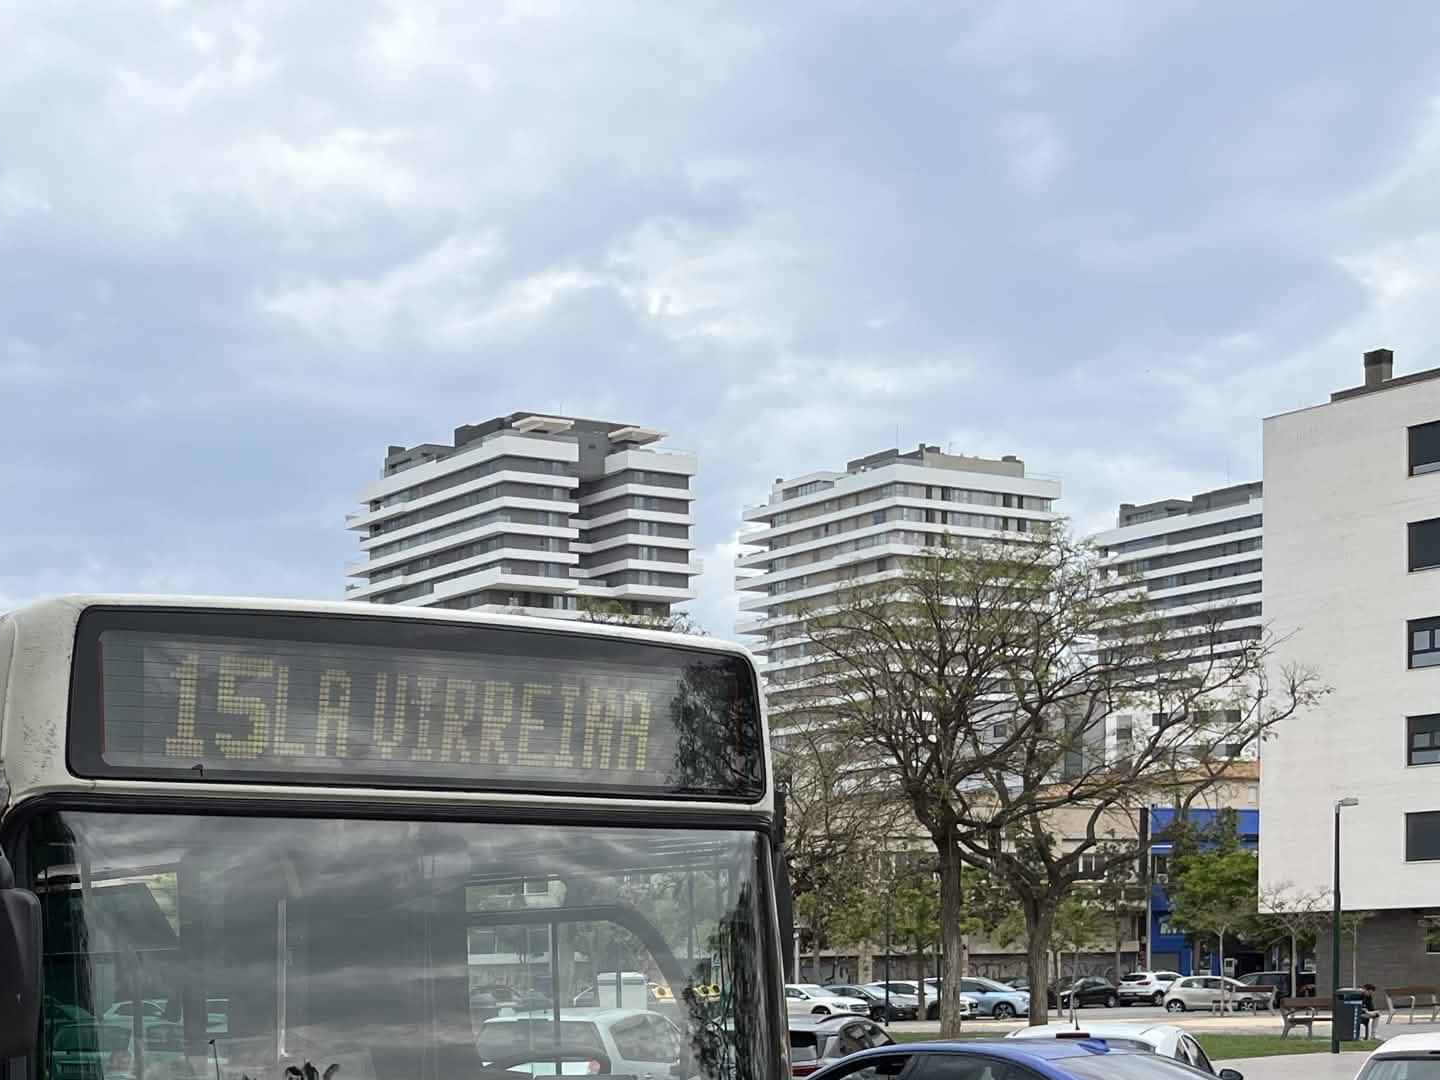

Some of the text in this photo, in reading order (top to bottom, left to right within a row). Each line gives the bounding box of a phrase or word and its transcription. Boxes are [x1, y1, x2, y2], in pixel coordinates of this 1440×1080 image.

[165, 654, 276, 760] 15
[273, 665, 652, 771] LA VIRREINA
